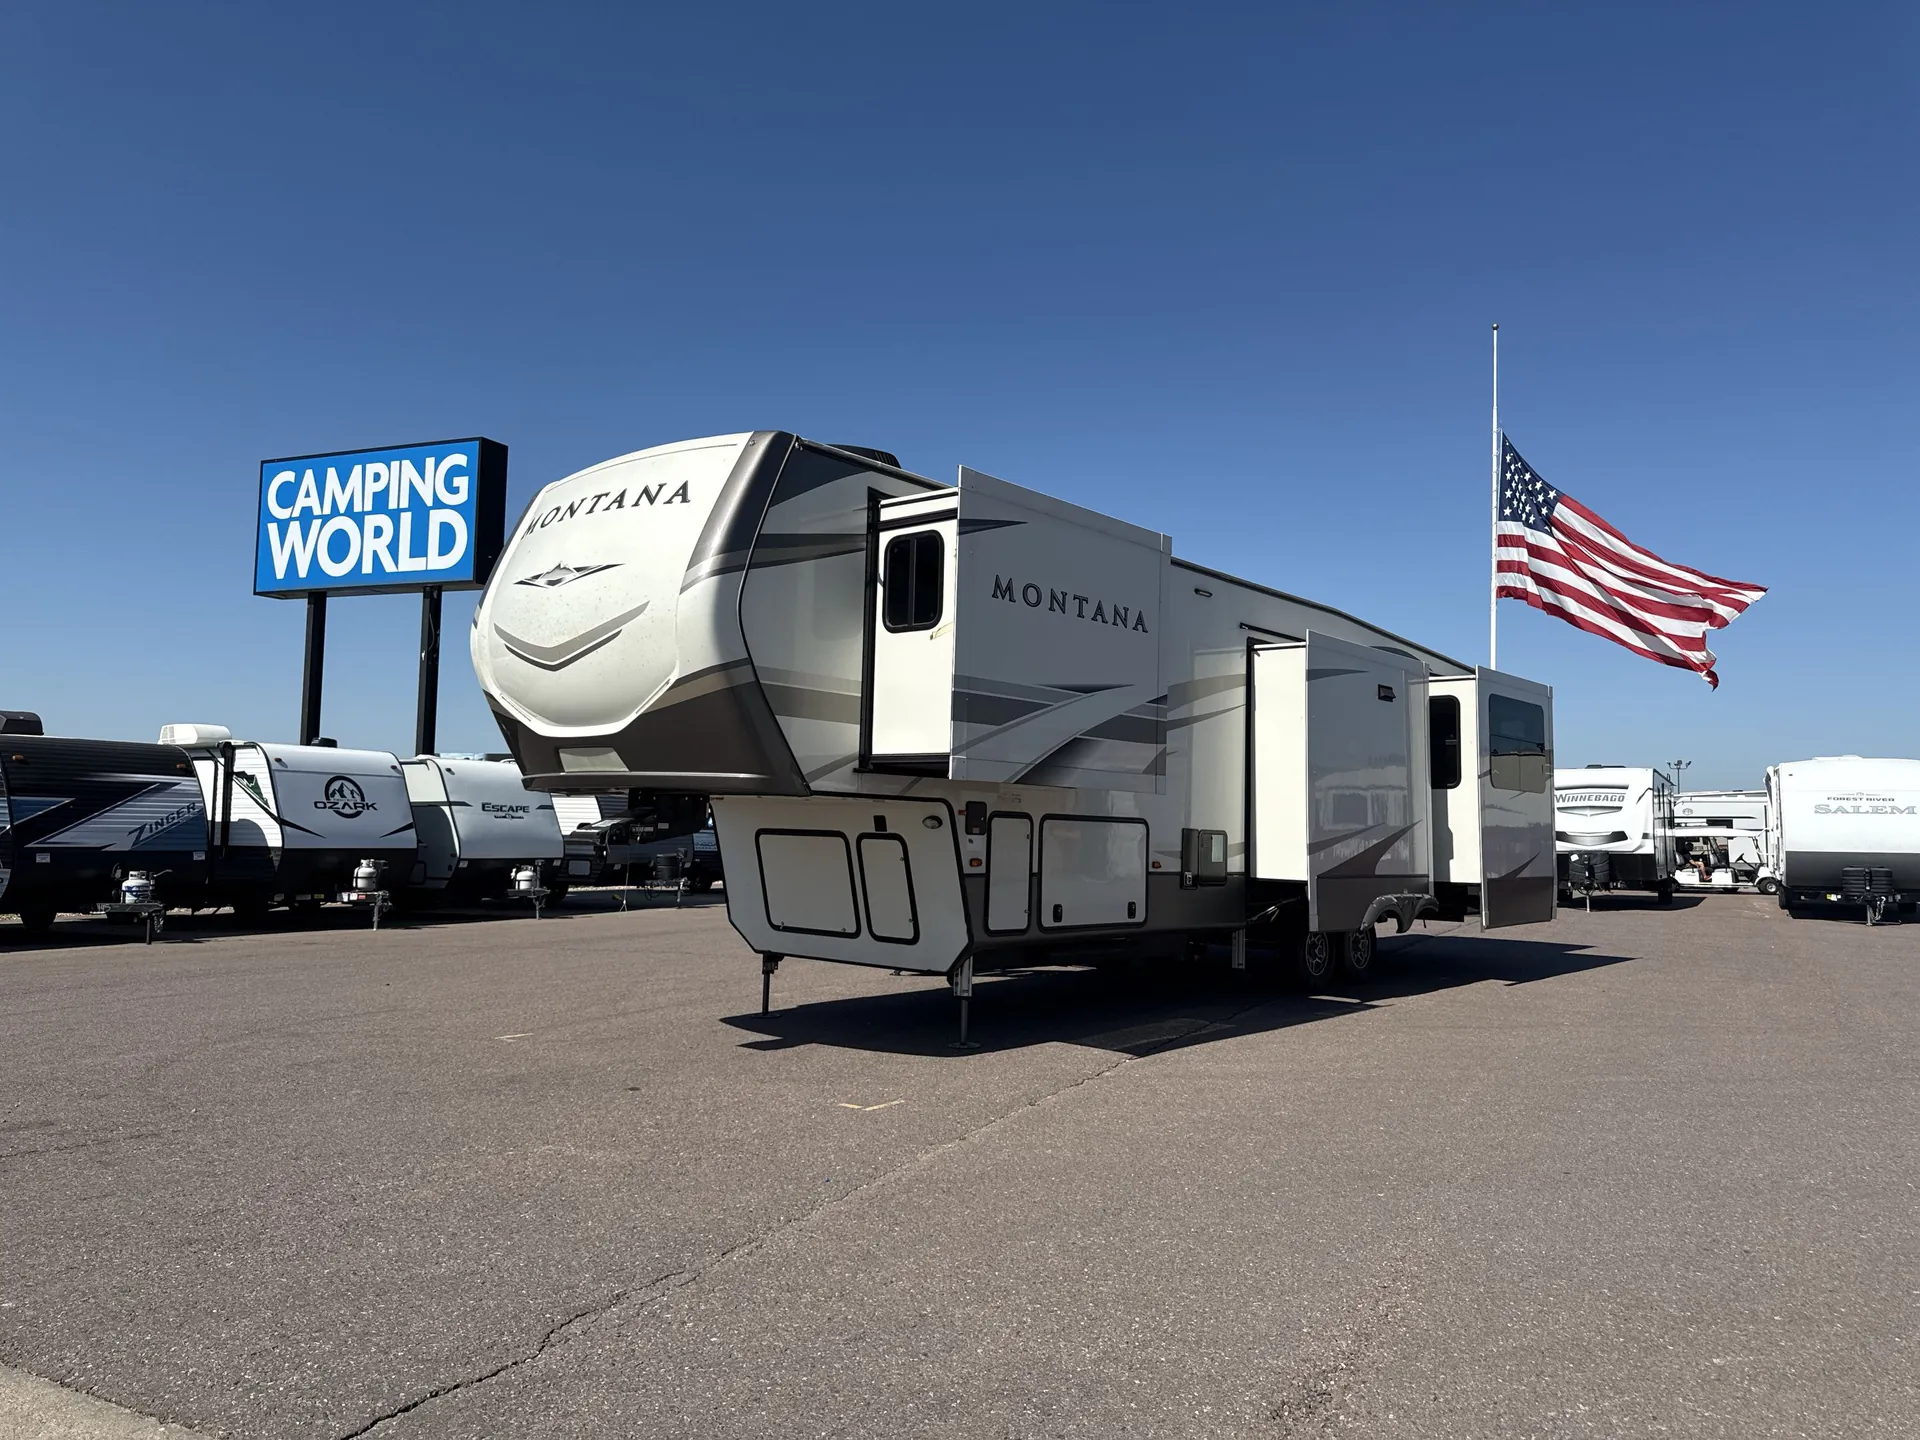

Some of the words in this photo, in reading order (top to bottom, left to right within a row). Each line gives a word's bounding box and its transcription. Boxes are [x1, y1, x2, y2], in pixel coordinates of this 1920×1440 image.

[267, 453, 469, 520] CAMPING
[521, 480, 691, 540] MONTANA
[267, 508, 468, 580] WORLD
[991, 574, 1149, 634] MONTANA
[313, 800, 378, 811] OZARK
[481, 802, 530, 813] ESCAPE
[1554, 793, 1626, 804] WINNEBAGO
[1814, 803, 1918, 815] SALEM
[127, 802, 197, 849] ZINGER
